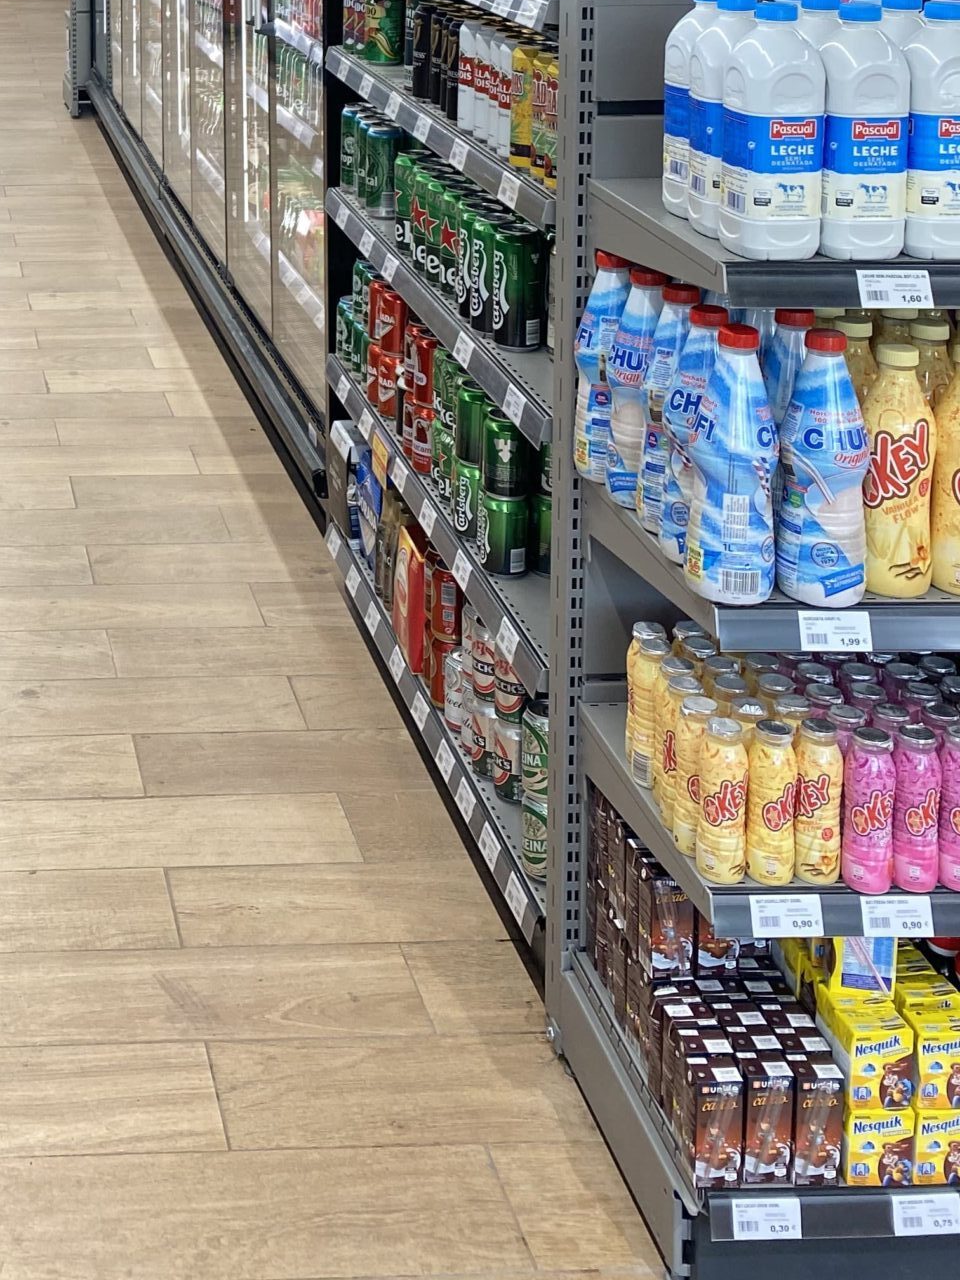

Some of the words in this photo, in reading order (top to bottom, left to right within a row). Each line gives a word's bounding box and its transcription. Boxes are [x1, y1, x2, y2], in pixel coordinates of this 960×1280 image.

[772, 123, 813, 135] Pascual
[855, 124, 897, 136] Pascual
[770, 145, 814, 156] LECHE
[853, 146, 898, 157] LECHE
[939, 144, 960, 154] LEC
[470, 238, 485, 317] Carlsberg
[492, 250, 506, 330] Carlsberg
[901, 295, 922, 304] 1,60
[864, 421, 928, 506] OKEY
[454, 477, 470, 531] Carlsberg
[840, 638, 860, 647] 1,99
[495, 681, 526, 695] ECK'S
[521, 753, 542, 767] EINA
[792, 920, 812, 929] 0,90
[902, 921, 922, 930] 0,90
[855, 1035, 901, 1057] Nesquik
[922, 1039, 960, 1055] Nesqui
[854, 1115, 902, 1134] Nesquik
[922, 1116, 960, 1135] Nesqui
[933, 1219, 953, 1228] 0,75
